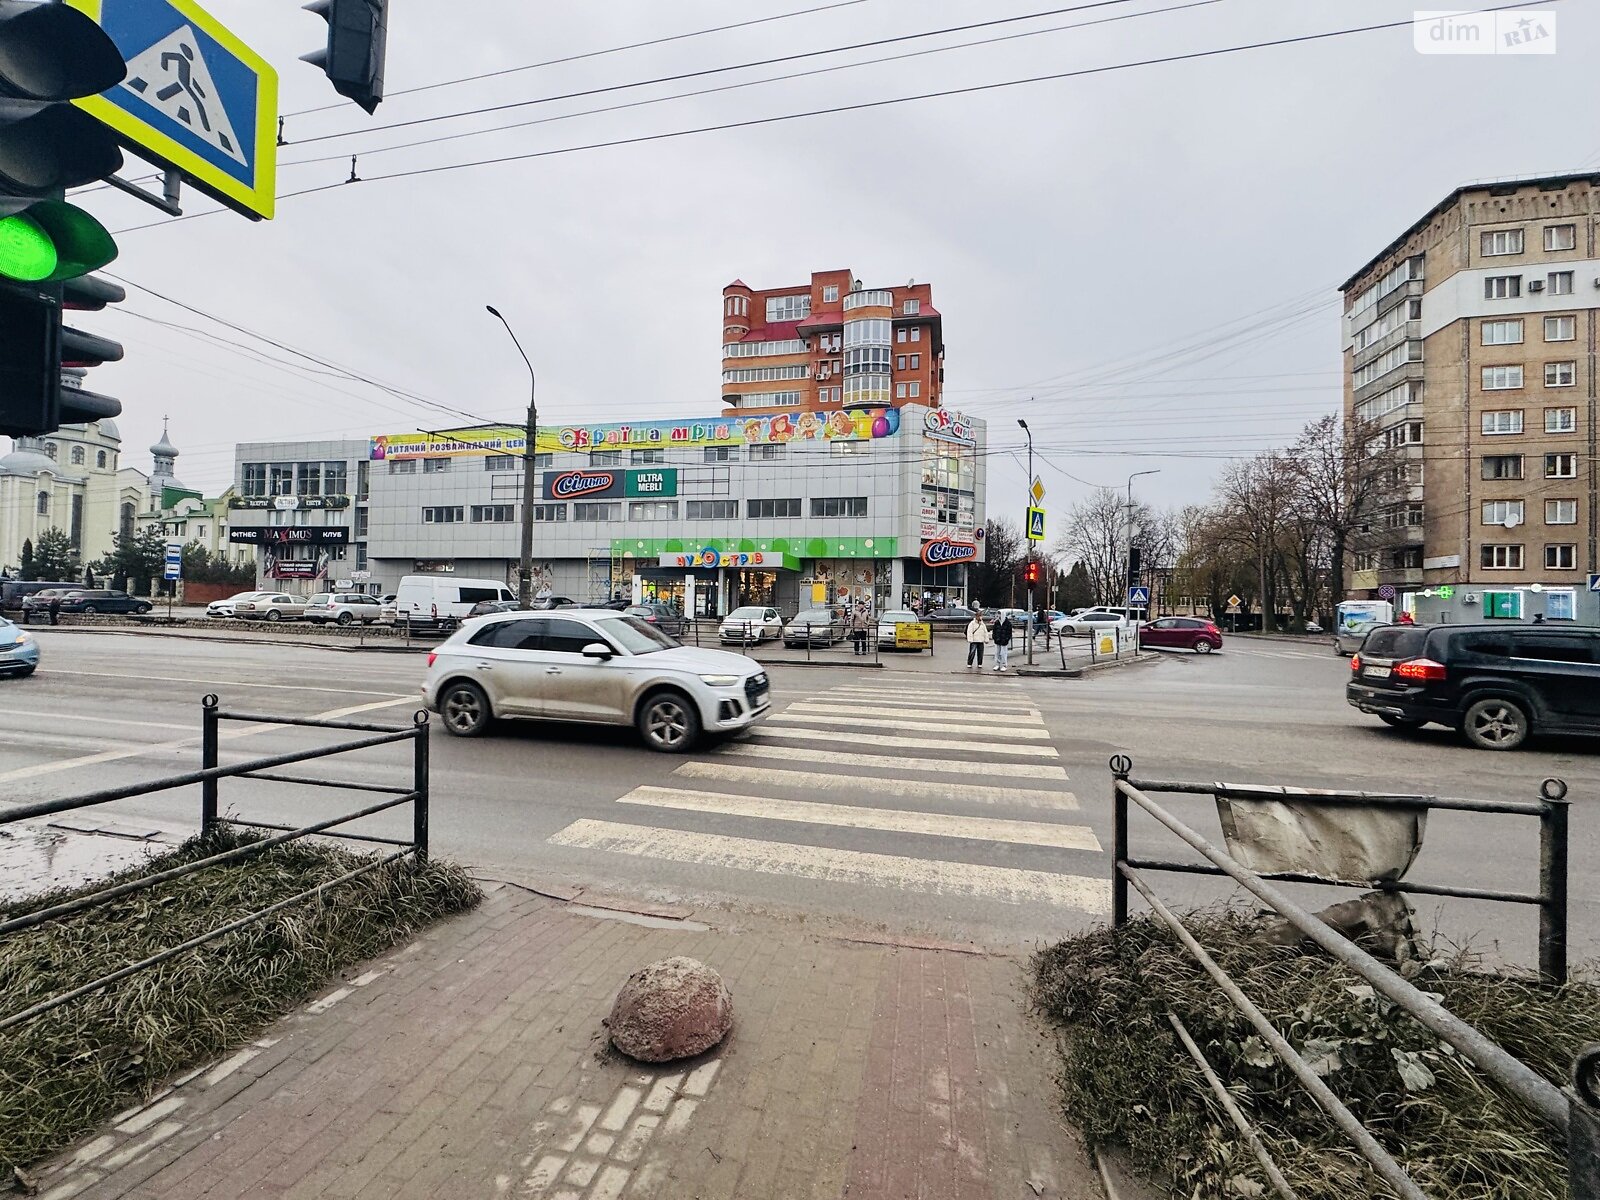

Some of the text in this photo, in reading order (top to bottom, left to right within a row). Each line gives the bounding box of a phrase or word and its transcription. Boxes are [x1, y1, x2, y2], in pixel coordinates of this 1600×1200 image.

[670, 422, 730, 443] мрій
[386, 438, 525, 455] ДИТЯЧИЙ РОЗВАЖАЛЬНИЙ ЦЕН
[557, 474, 610, 494] Сільпо
[637, 473, 663, 483] ULTRA
[638, 482, 663, 492] MEBLI
[263, 528, 313, 540] MAXIMUS
[927, 540, 975, 562] Сільпо
